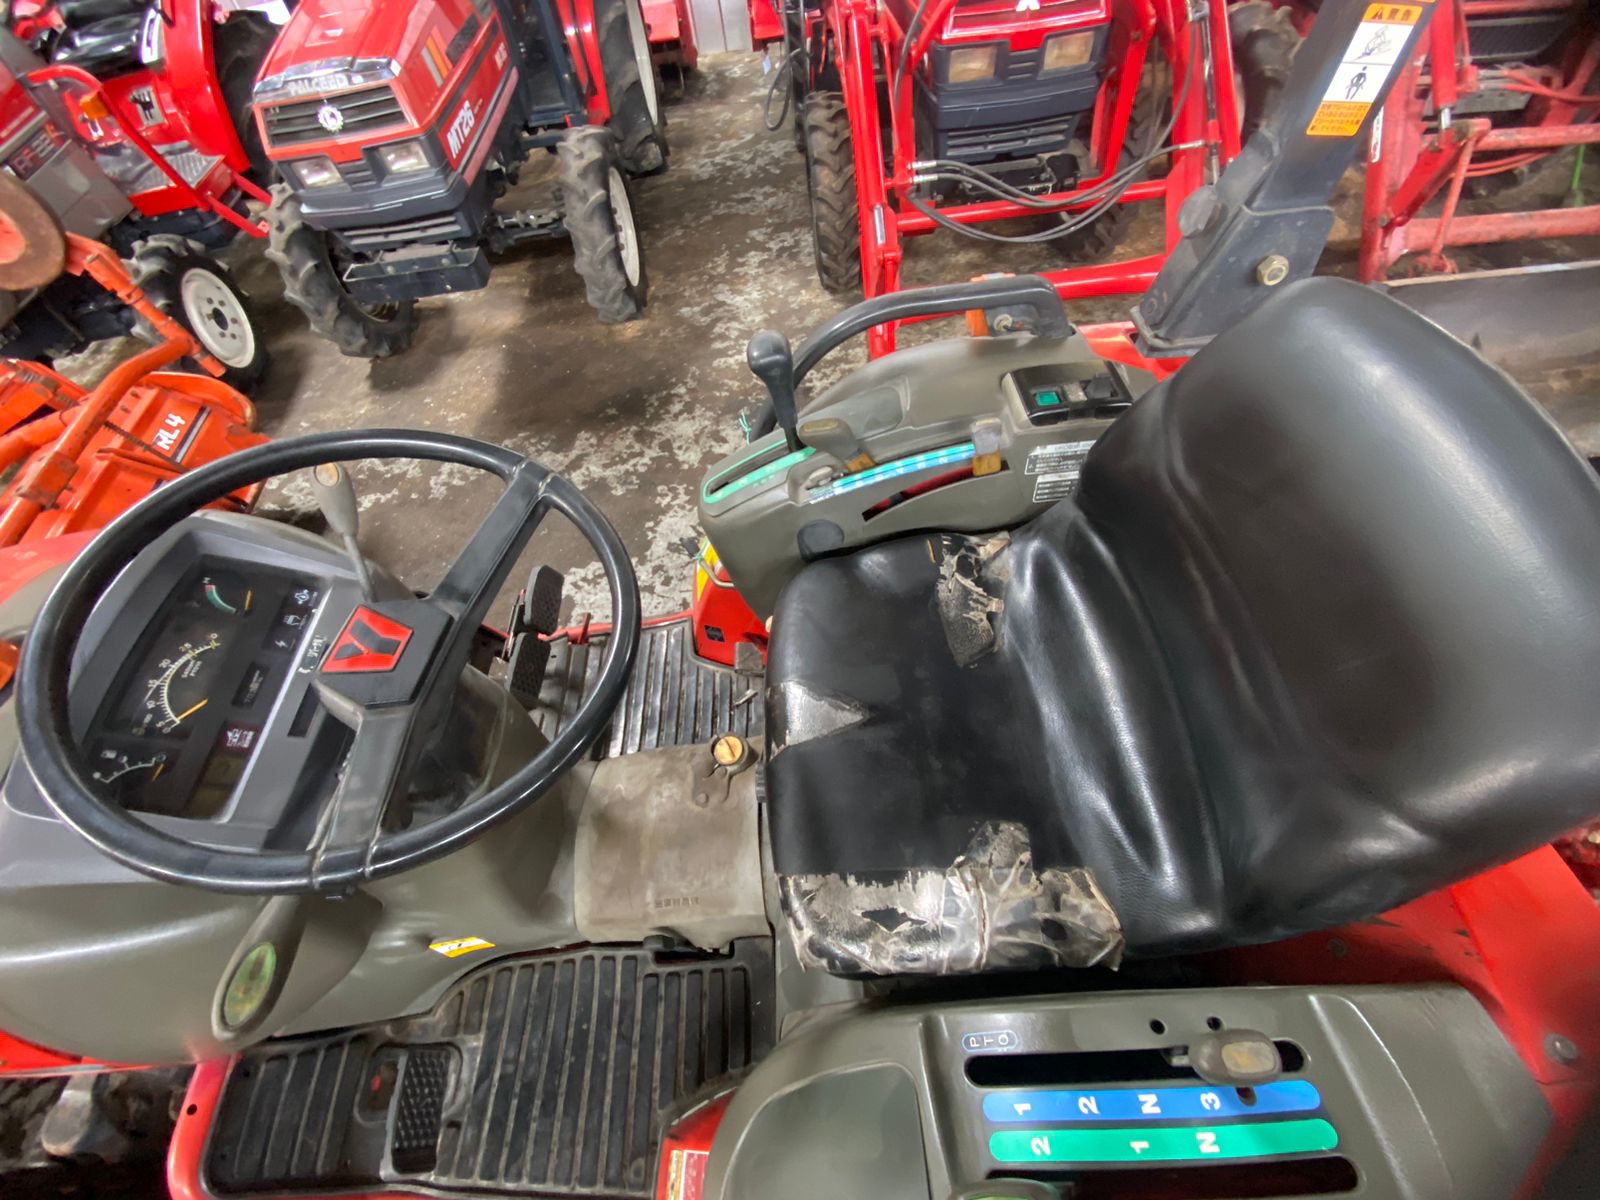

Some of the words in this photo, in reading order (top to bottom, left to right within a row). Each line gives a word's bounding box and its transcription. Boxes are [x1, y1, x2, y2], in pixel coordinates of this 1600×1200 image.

[447, 99, 475, 159] MT26
[969, 1033, 1009, 1048] PTO
[1013, 1102, 1032, 1116] 1
[1078, 1096, 1100, 1115] 2
[1137, 1093, 1162, 1114] N
[1200, 1091, 1221, 1111] 3
[1030, 1136, 1051, 1156] 2
[1129, 1140, 1150, 1154] 1
[1196, 1131, 1220, 1153] N
